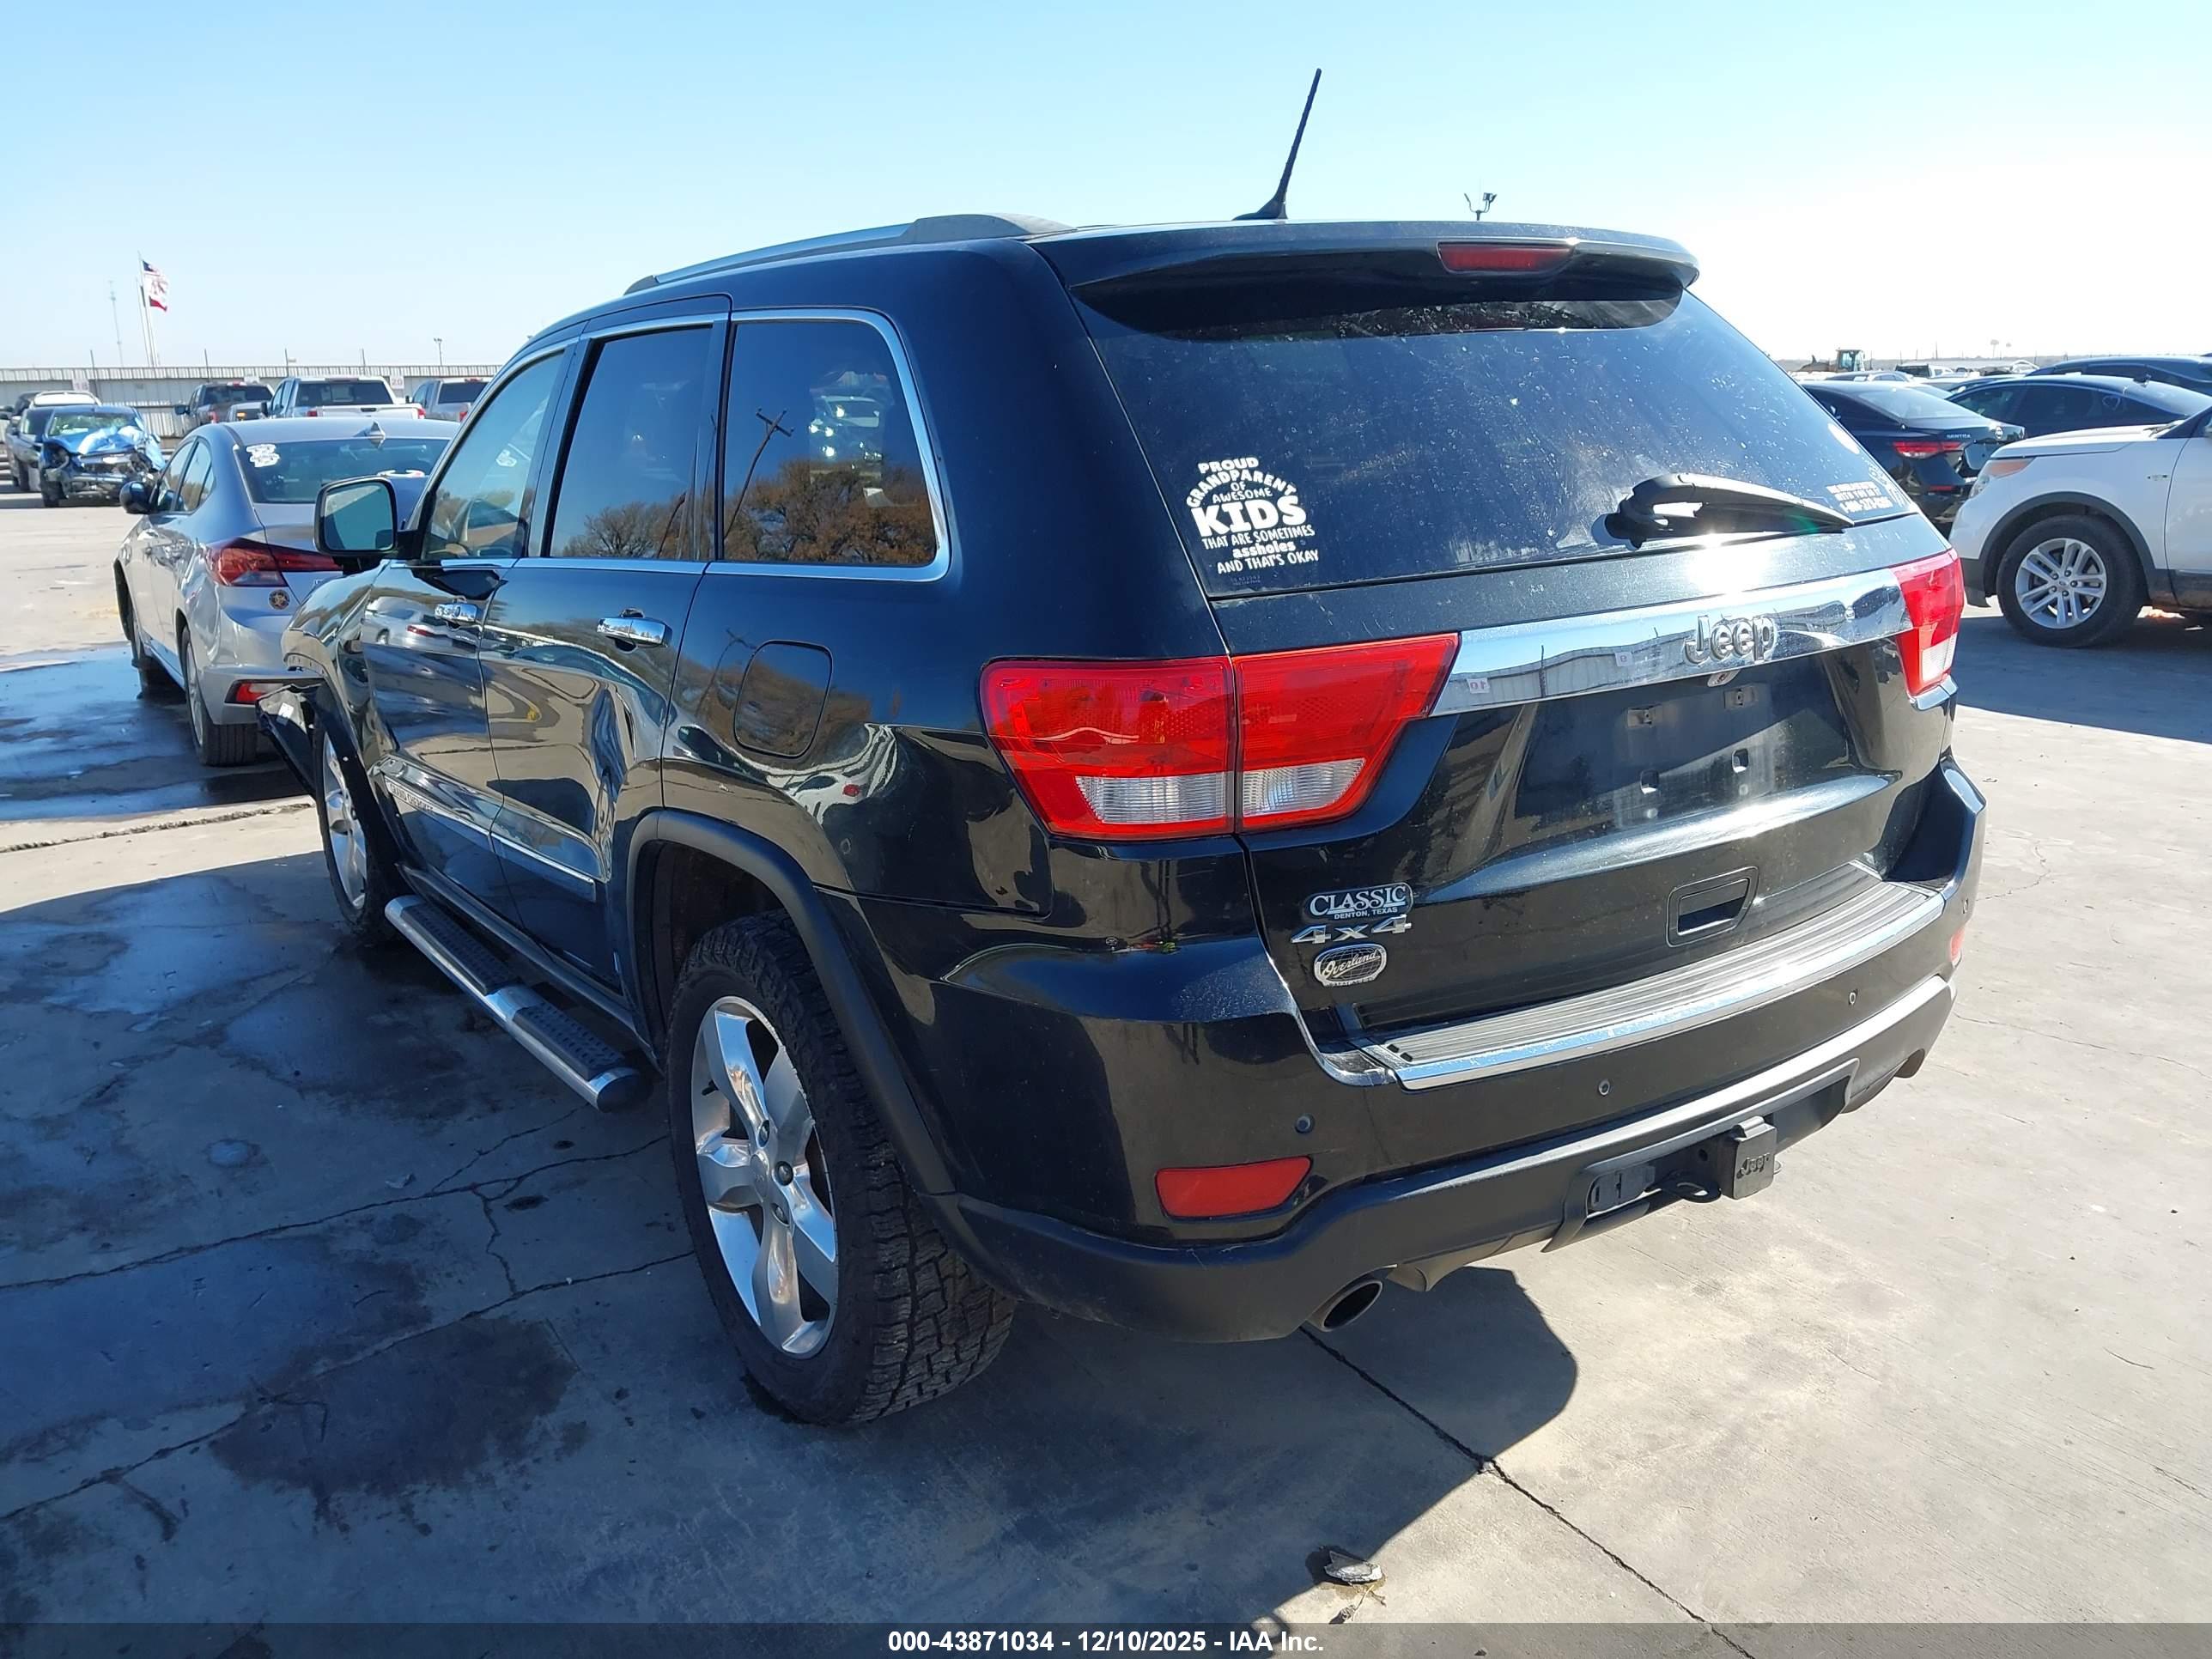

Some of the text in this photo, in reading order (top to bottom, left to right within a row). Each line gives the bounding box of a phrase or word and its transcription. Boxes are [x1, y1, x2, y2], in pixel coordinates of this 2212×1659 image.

[1197, 457, 1260, 474] PROUD
[1186, 469, 1297, 508] GRANDPARENT
[1212, 487, 1273, 504] AWESOME
[1230, 482, 1247, 492] OF
[1191, 495, 1307, 538] KIDS
[1201, 524, 1316, 550] THAT ARE SOMETIMES
[1217, 550, 1320, 574] AND THAT'S OKAY
[1232, 541, 1297, 559] assholes
[1685, 615, 1775, 665] Jeep
[1310, 885, 1407, 916] CLASSIC
[1334, 906, 1398, 921] DENTON, TEXAS
[1322, 947, 1381, 980] Overland
